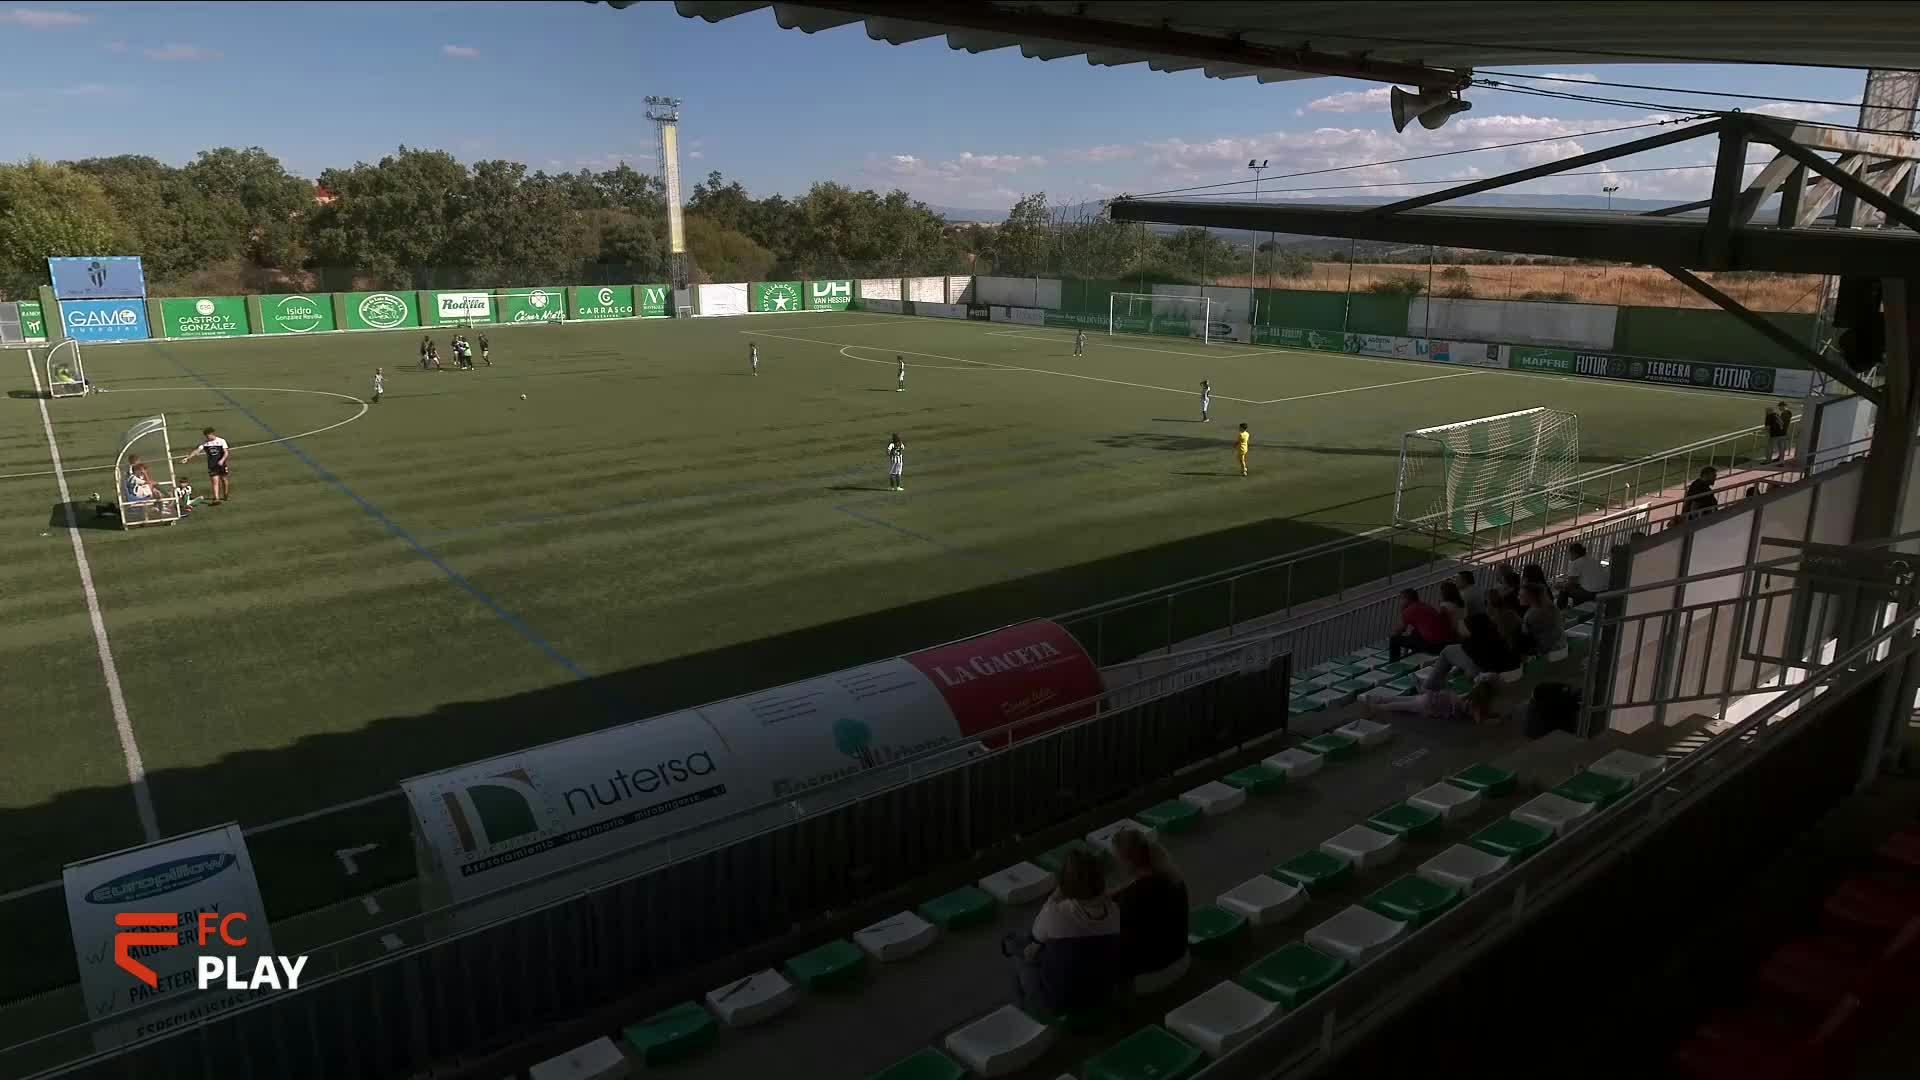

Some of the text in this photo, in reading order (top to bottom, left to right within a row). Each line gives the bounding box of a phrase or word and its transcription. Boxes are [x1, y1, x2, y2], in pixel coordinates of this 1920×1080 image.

[442, 297, 486, 311] Rodilla
[827, 296, 851, 304] HESSEN
[68, 309, 137, 326] GAMO
[287, 306, 311, 316] Isidro
[579, 305, 633, 315] CARRASCO
[178, 315, 221, 324] CASTRO
[1521, 357, 1569, 369] MAPFRE
[1575, 355, 1608, 376] FUTUR
[1647, 361, 1691, 378] TERCERA
[1712, 367, 1751, 389] FUTUR
[968, 640, 1061, 676] GACETA
[563, 750, 721, 816] nutersa
[463, 839, 555, 877] Asesoramiento
